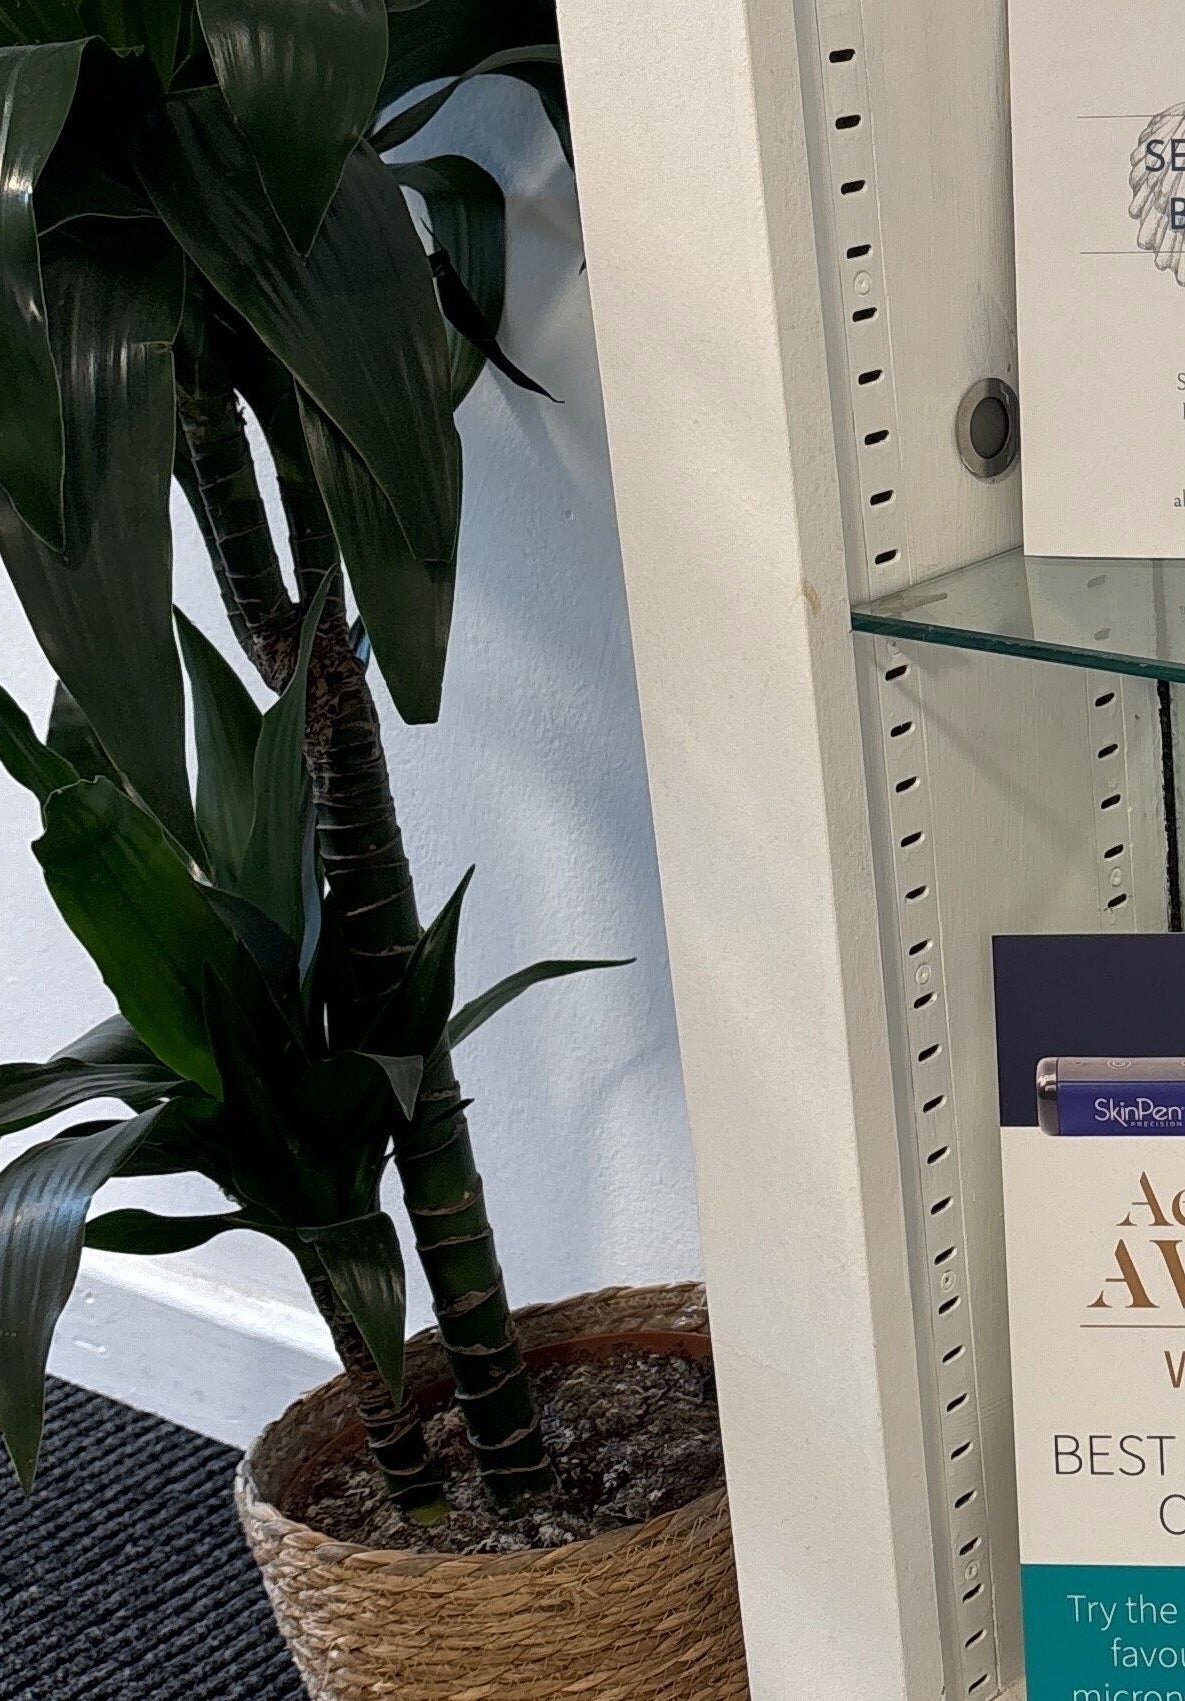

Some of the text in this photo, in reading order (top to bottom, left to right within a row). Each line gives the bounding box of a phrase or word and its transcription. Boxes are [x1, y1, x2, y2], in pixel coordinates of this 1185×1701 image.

[1053, 1434, 1176, 1477] BEST
[1067, 1594, 1117, 1631] Try
[1125, 1594, 1177, 1625] the
